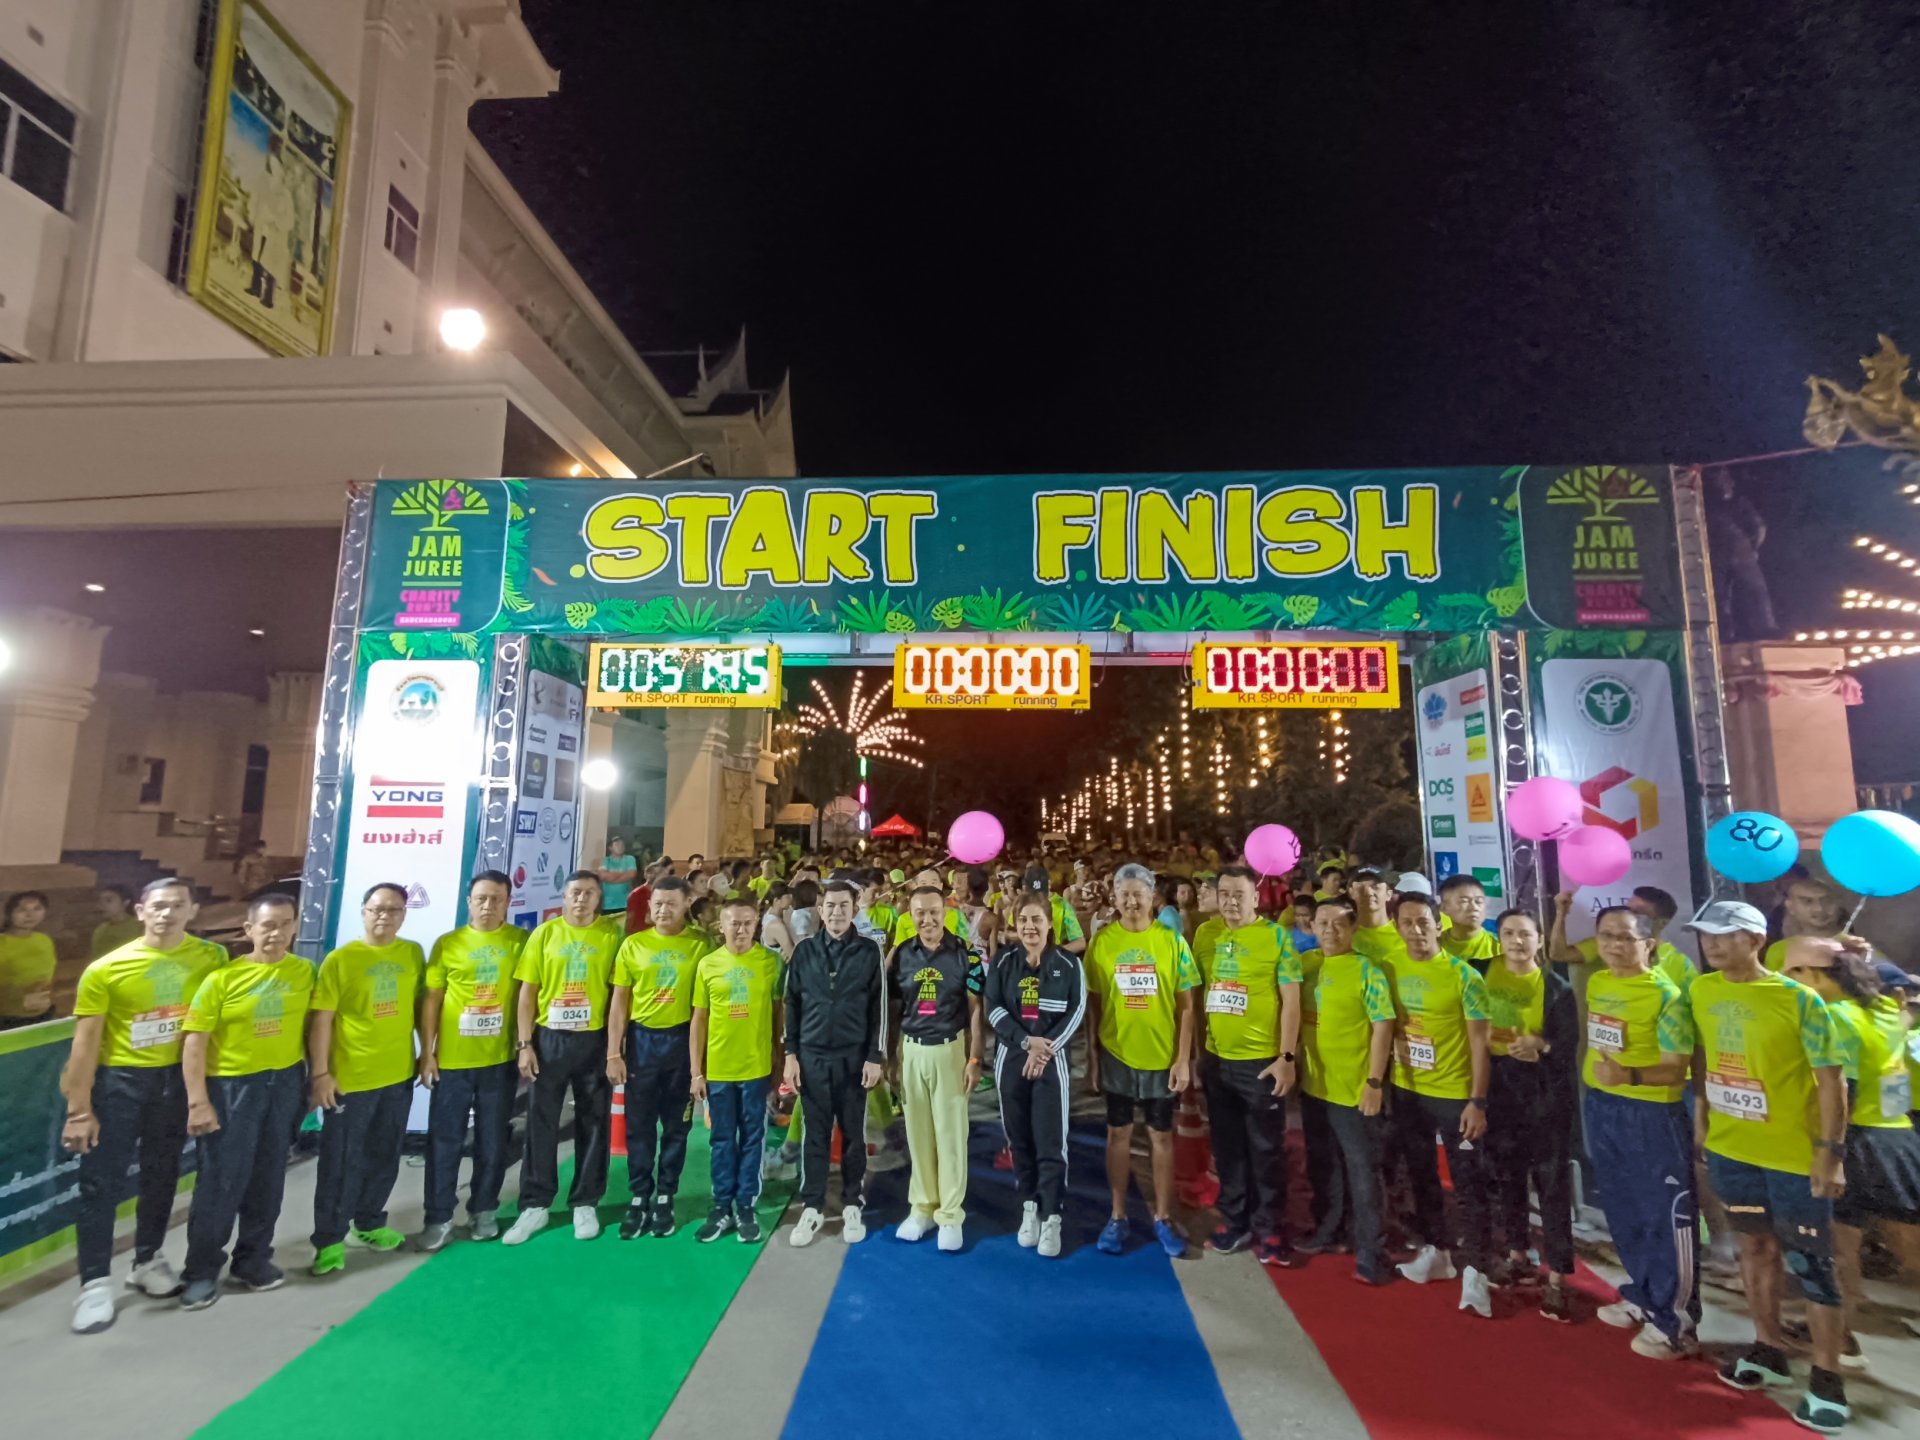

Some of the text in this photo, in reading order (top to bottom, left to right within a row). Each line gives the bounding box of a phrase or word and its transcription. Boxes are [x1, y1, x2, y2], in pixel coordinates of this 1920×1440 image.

[584, 484, 1441, 587] START FINISH
[1573, 525, 1635, 549] JAM
[408, 535, 461, 557] JAM
[402, 560, 462, 576] JUREE
[1572, 551, 1640, 570] JUREE
[1207, 647, 1386, 693] 00:00:00
[626, 693, 737, 706] KR.SPORT running
[925, 695, 1058, 708] KR.SPORT running
[1238, 693, 1357, 706] KR.SPORT running
[1429, 778, 1454, 797] DOS
[372, 790, 444, 802] YONG
[1730, 818, 1783, 851] 80
[1130, 976, 1155, 986] 0491
[1220, 994, 1246, 1007] 0473
[562, 1009, 588, 1020] 0341
[1407, 1046, 1432, 1060] 785
[1723, 1090, 1763, 1110] 0493
